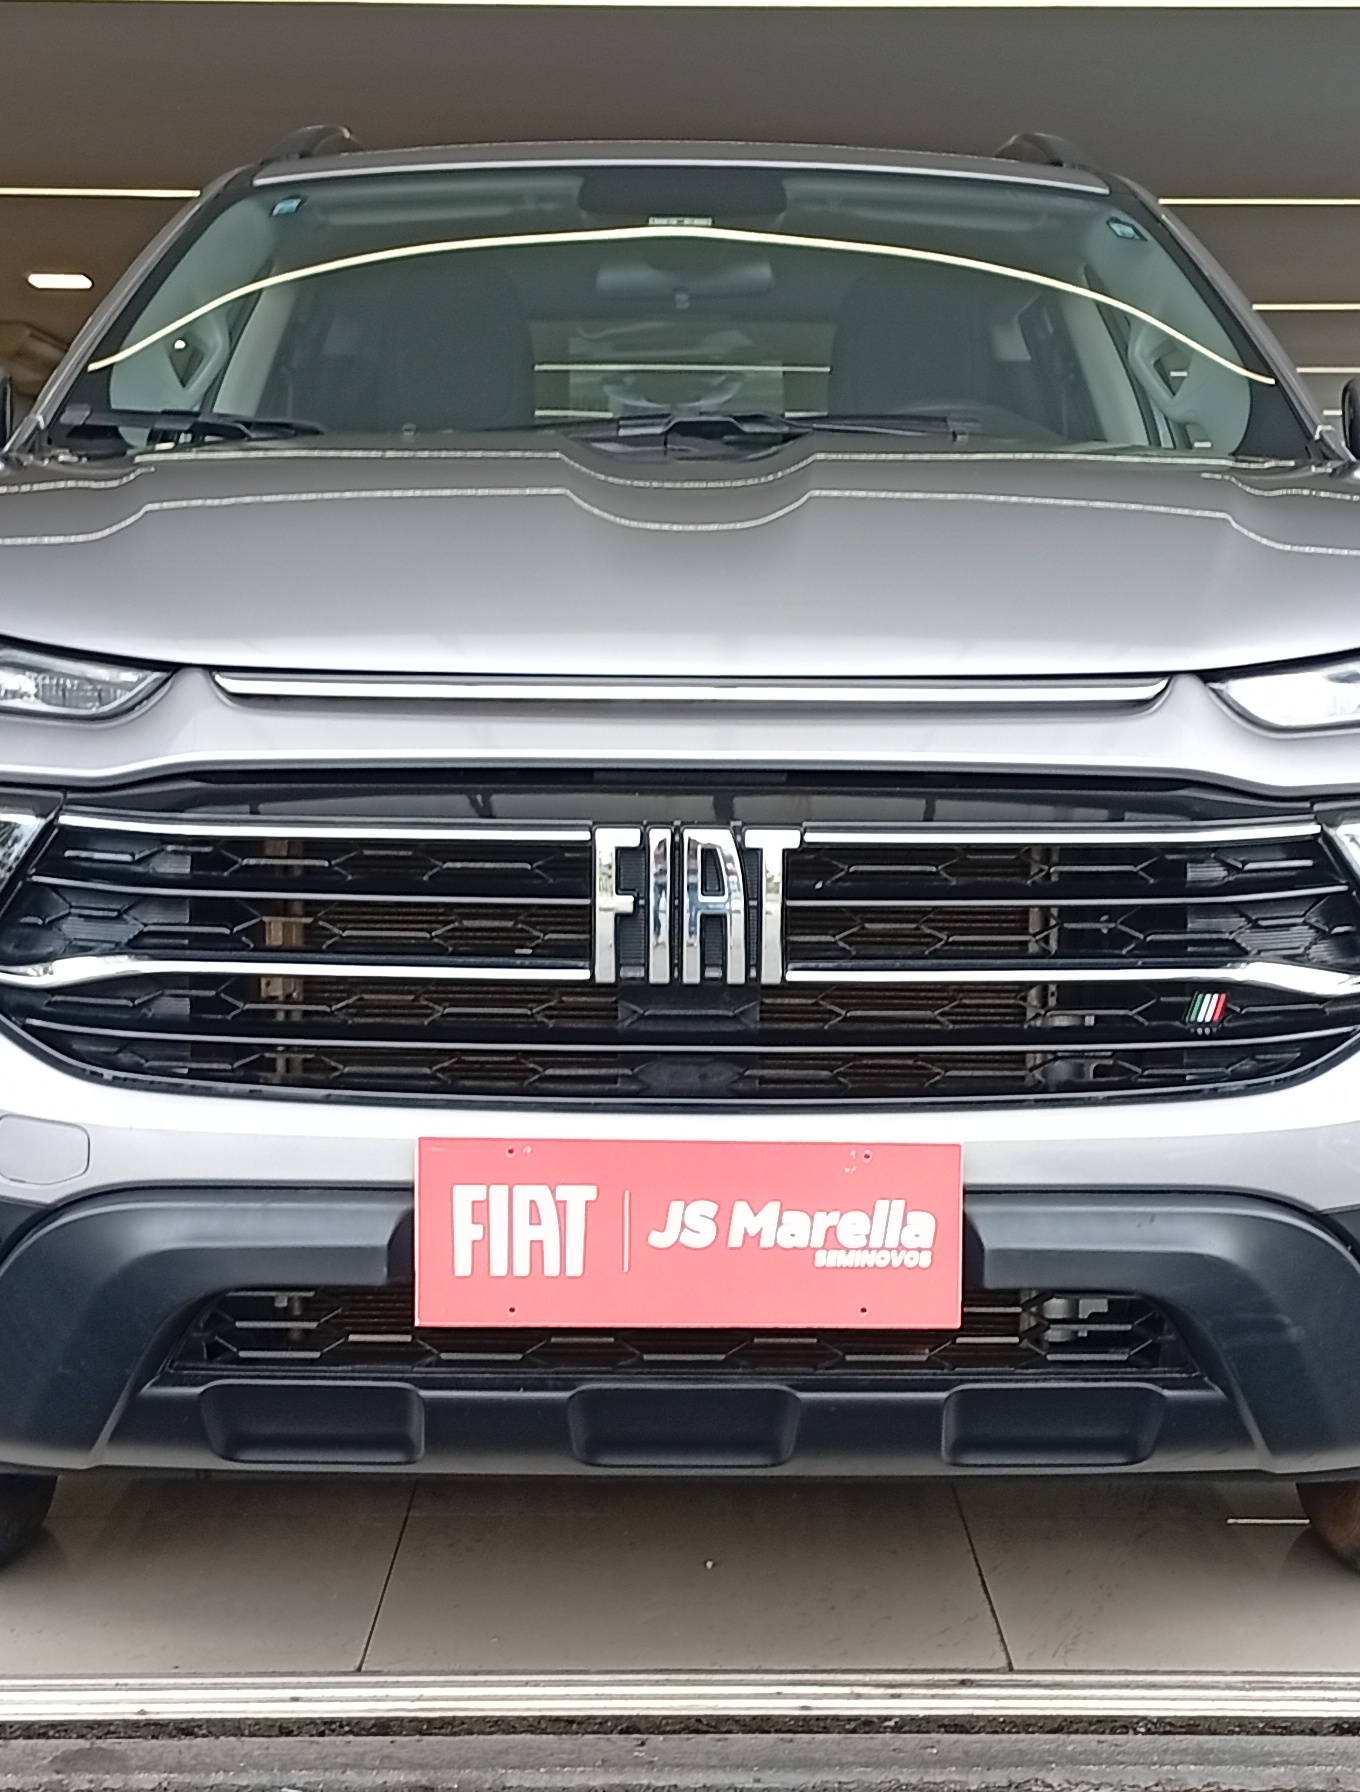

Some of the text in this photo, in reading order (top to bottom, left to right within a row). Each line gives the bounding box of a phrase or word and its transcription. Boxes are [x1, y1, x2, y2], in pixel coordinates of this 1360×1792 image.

[595, 828, 801, 984] FIAT
[452, 1184, 597, 1277] FIAT
[647, 1199, 937, 1249] JS Marella
[814, 1250, 933, 1269] SEMINOVOS
